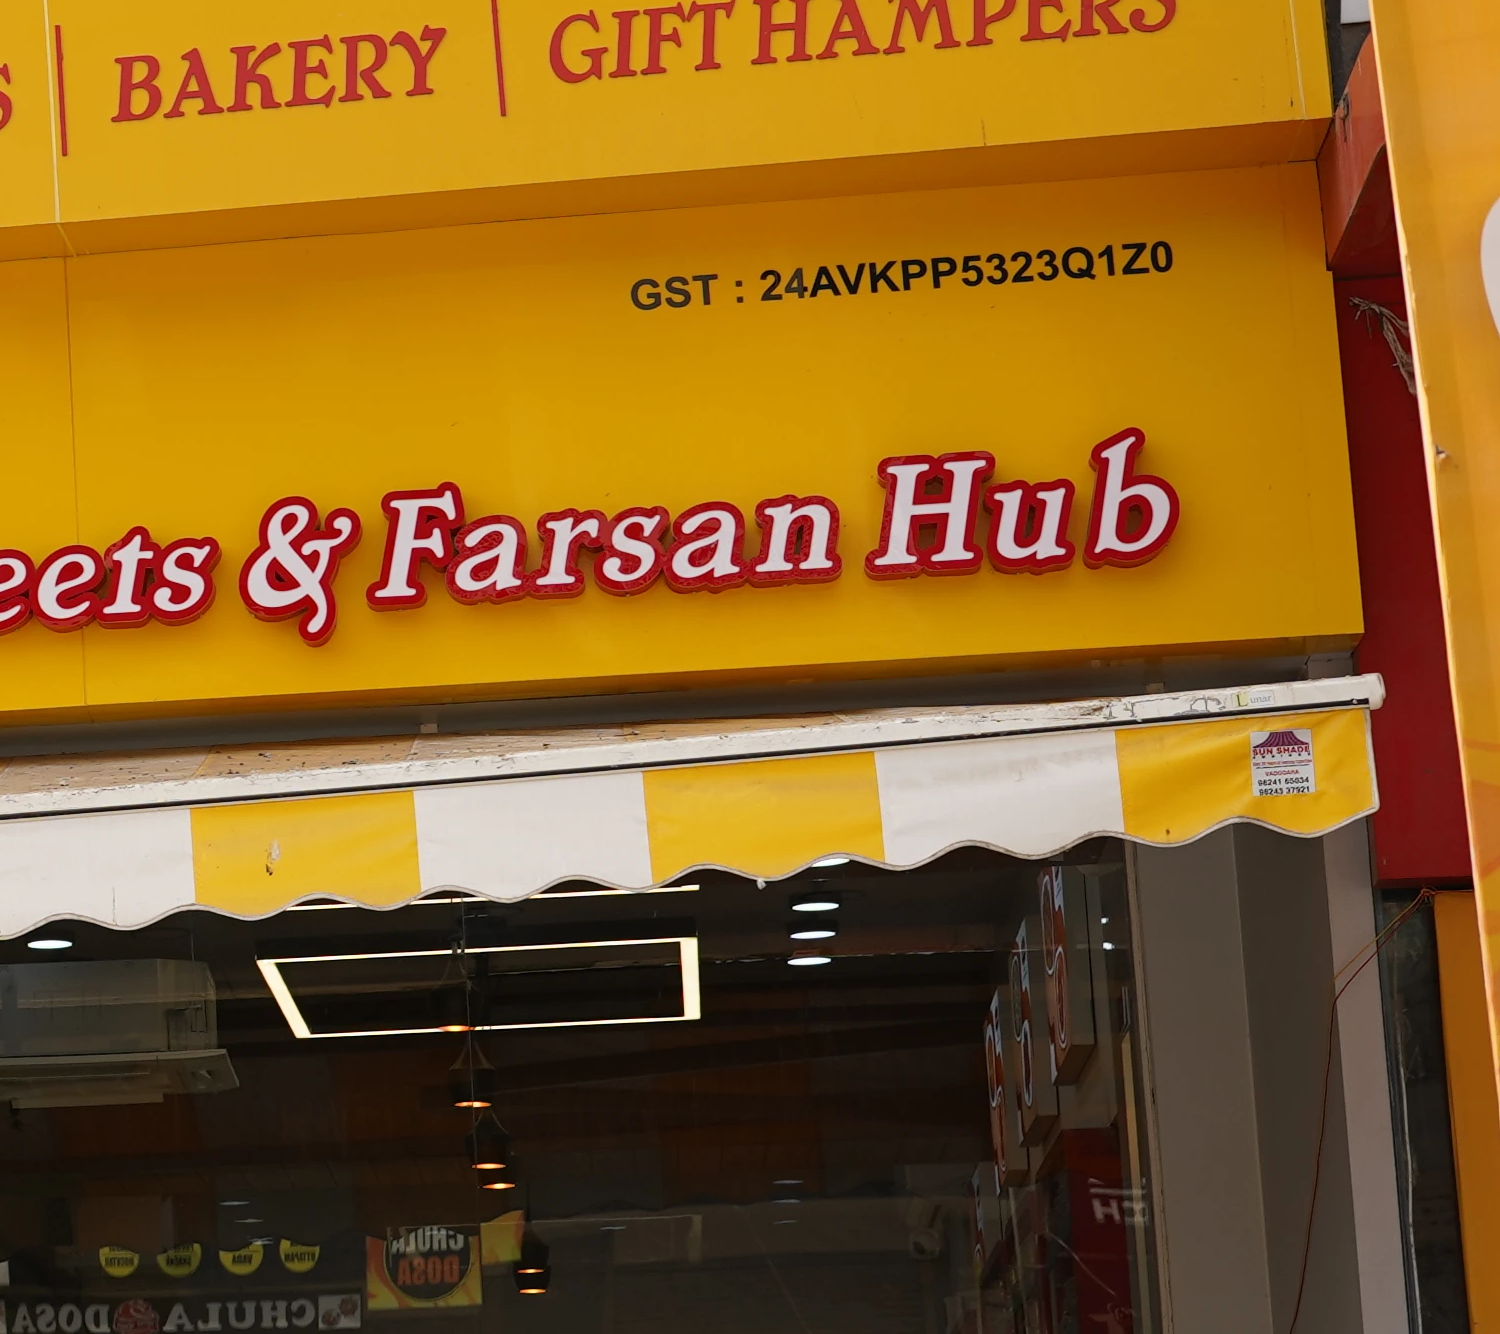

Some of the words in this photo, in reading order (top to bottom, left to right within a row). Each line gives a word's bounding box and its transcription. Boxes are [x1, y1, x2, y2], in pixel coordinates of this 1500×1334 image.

[109, 22, 448, 126] BAKERY
[630, 274, 718, 311] GST
[760, 240, 1173, 302] 24AVKPP5323Q1Z0
[239, 494, 361, 648] &
[367, 481, 842, 611] Farsan
[864, 425, 1180, 580] Hub
[1252, 747, 1272, 756] SUN
[1276, 746, 1310, 754] SHADE
